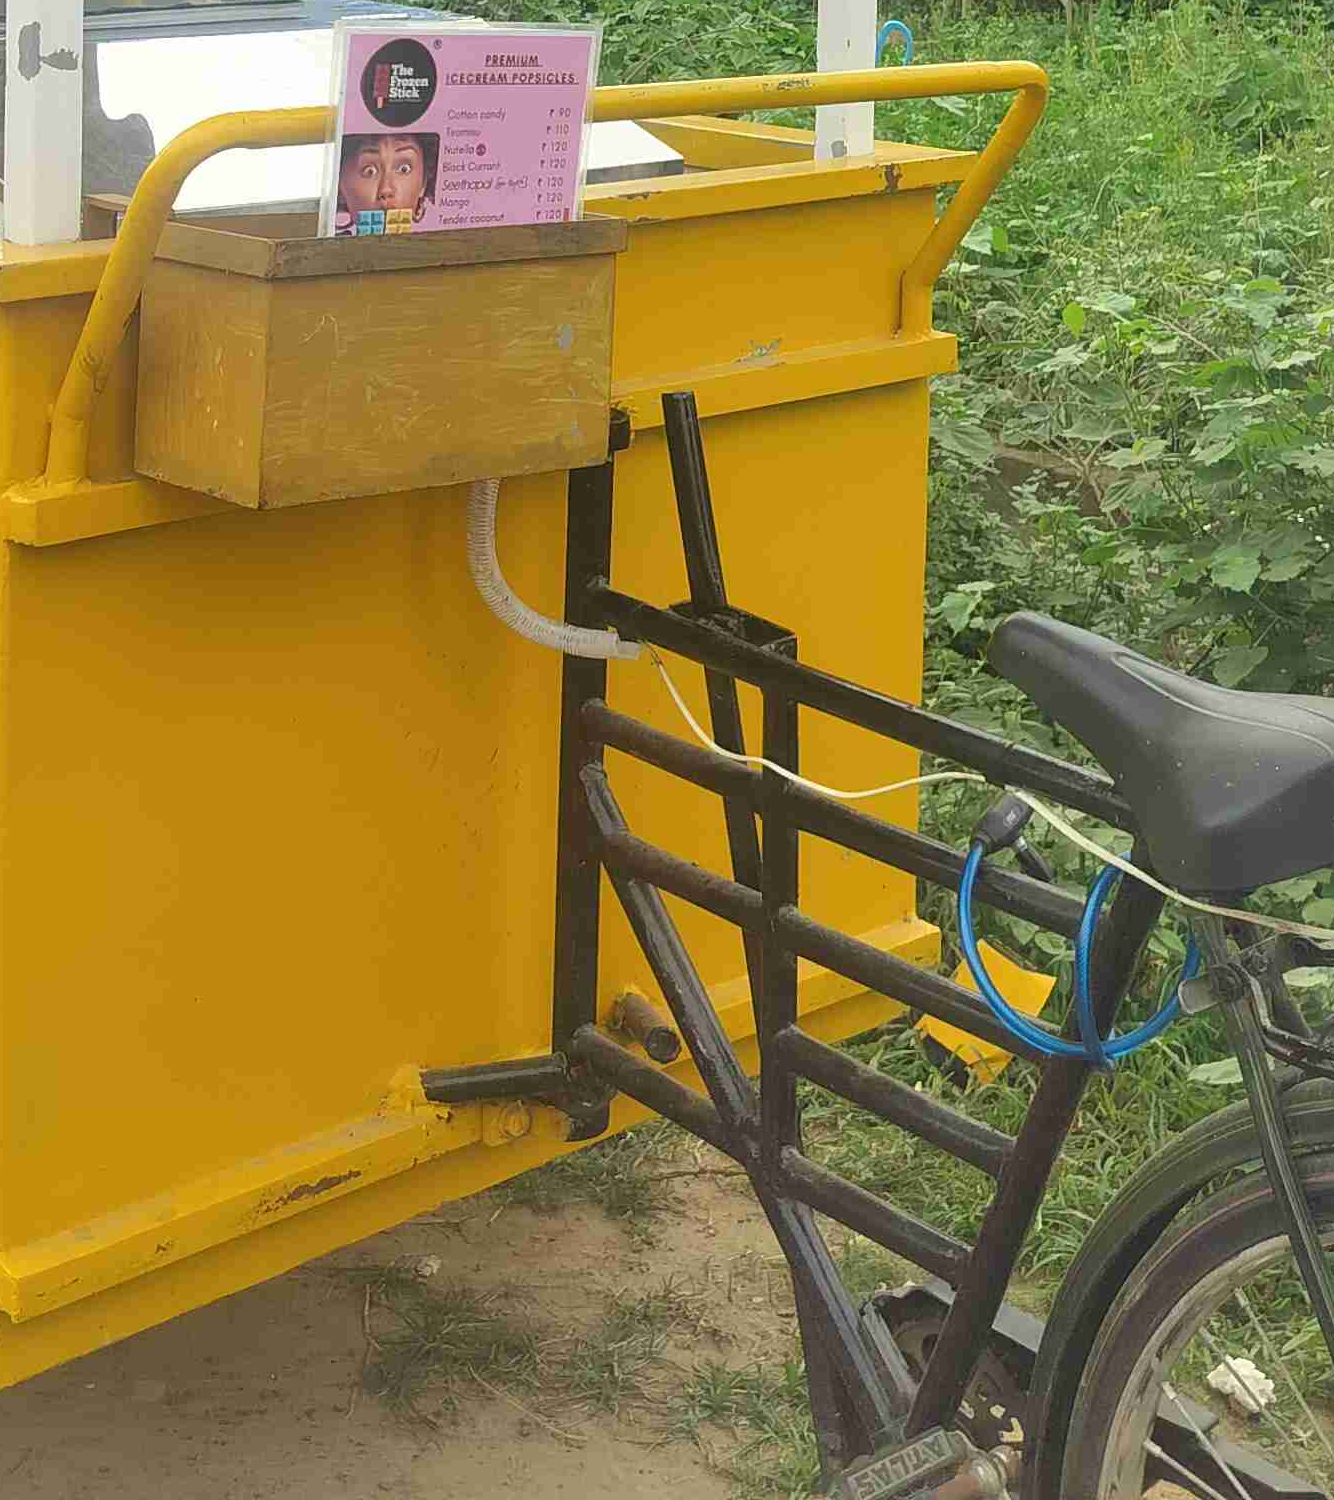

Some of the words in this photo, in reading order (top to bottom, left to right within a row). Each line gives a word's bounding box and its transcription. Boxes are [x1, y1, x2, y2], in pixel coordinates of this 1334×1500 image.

[484, 54, 539, 67] PREMIUM
[391, 63, 414, 76] The
[390, 76, 429, 87] Frozen
[445, 73, 508, 85] ICECREAM
[512, 72, 575, 85] POPSICLES
[389, 86, 419, 98] Stick
[558, 107, 571, 118] 90
[550, 141, 568, 152] 120
[548, 158, 566, 169] 120
[546, 177, 564, 188] 120
[546, 192, 563, 203] 120
[544, 210, 562, 220] 120
